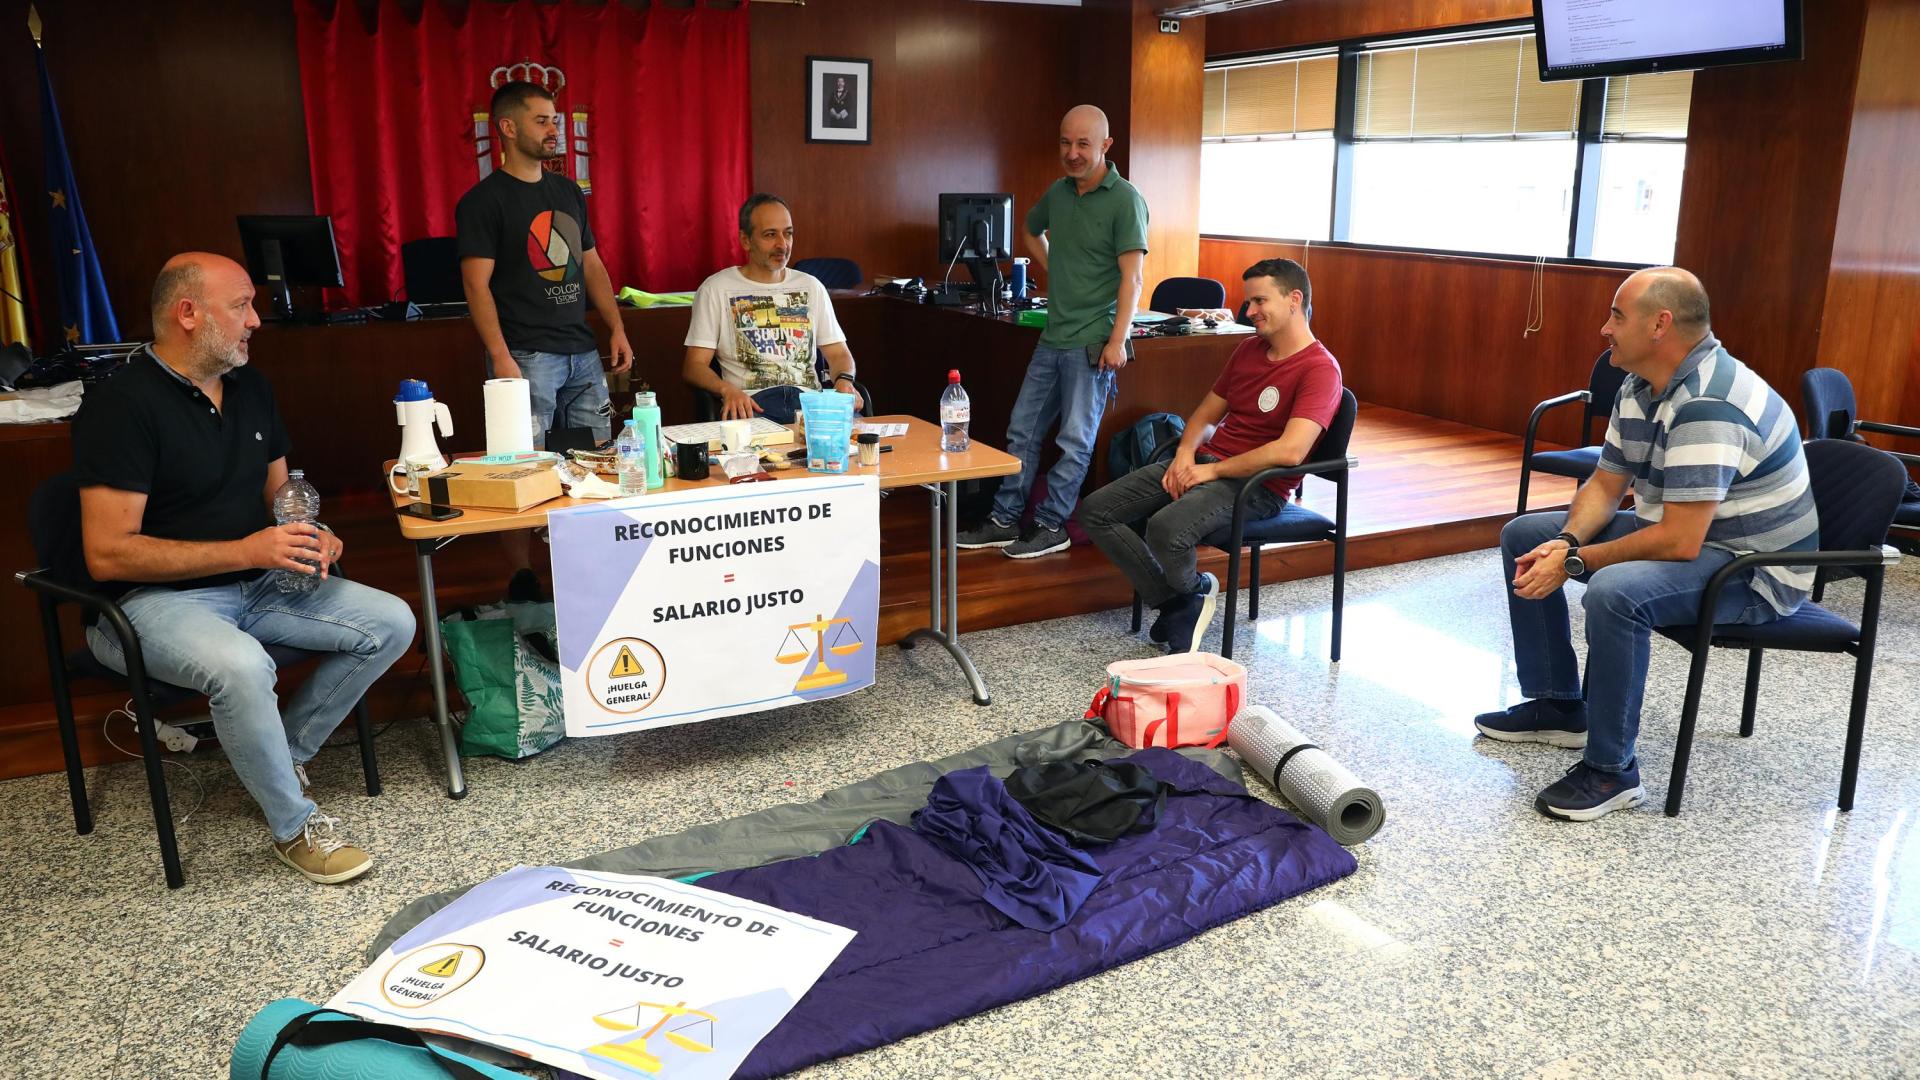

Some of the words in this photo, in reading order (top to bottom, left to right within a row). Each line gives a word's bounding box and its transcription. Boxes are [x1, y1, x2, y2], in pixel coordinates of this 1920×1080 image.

[544, 282, 580, 297] VOLCOM
[614, 507, 802, 542] RECONOCIMIENTO
[808, 502, 832, 520] DE
[669, 535, 785, 564] FUNCIONES
[653, 597, 741, 623] SALARIO
[745, 588, 804, 616] JUSTO
[606, 692, 651, 705] GENERAL!
[607, 680, 648, 694] ¡HUELGA
[544, 880, 742, 929] RECONOCIMIENTO
[745, 921, 779, 937] DE
[572, 901, 704, 943] FUNCIONES
[507, 930, 609, 970] SALARIO
[605, 963, 685, 988] JUSTO
[389, 985, 438, 1001] GENERAL!
